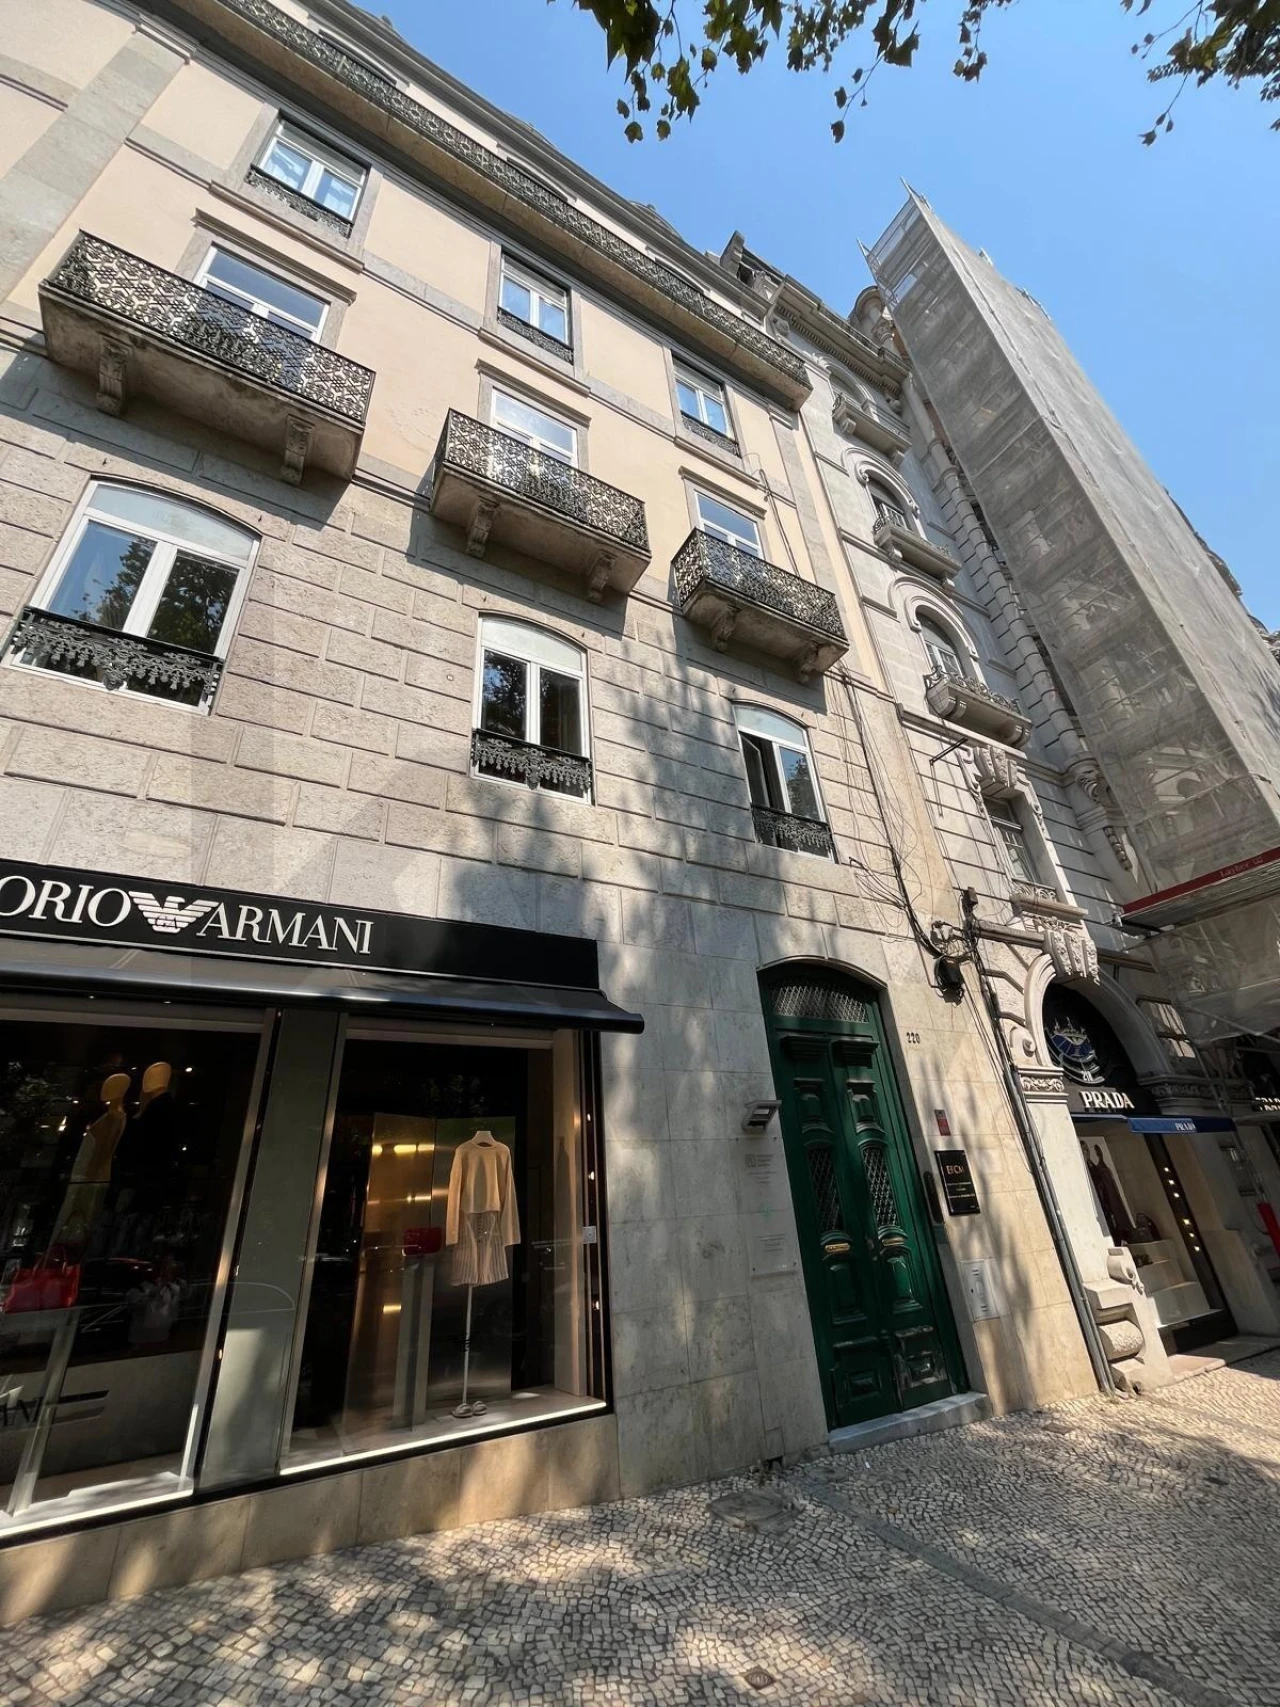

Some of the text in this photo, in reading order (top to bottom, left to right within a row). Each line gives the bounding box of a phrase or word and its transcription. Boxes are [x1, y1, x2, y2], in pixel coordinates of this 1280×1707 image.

[196, 901, 375, 955] ARMANI
[906, 1032, 921, 1044] 220
[1081, 1090, 1135, 1109] PRADA
